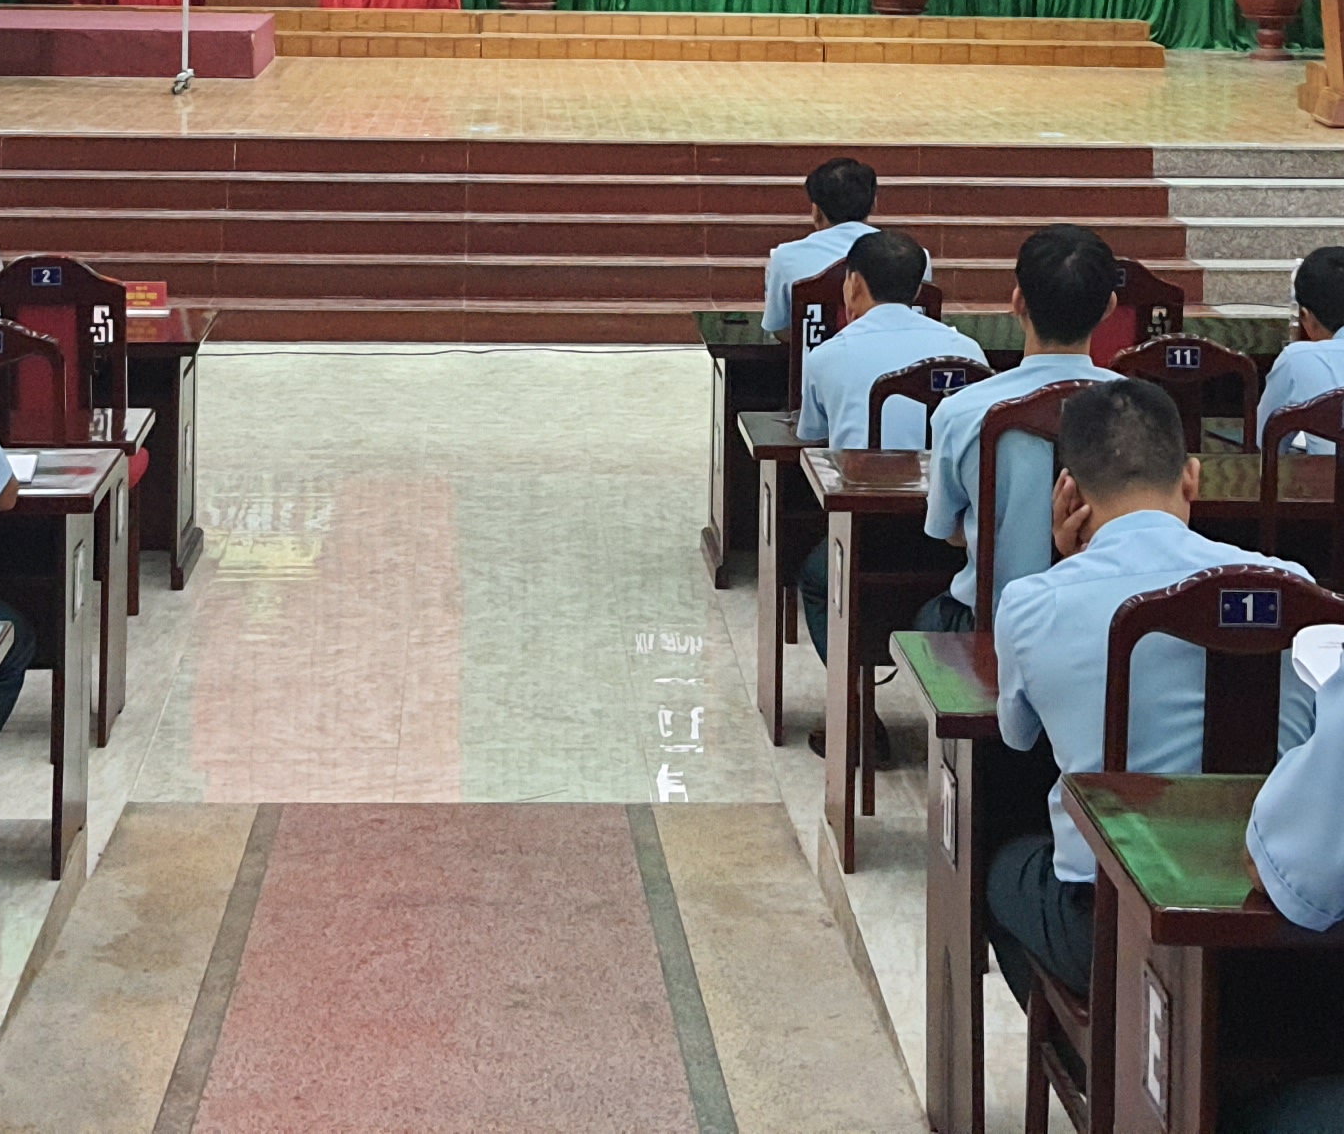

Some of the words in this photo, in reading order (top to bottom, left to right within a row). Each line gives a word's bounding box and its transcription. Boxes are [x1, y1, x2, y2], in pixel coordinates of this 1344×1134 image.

[42, 269, 51, 283] 2
[1173, 348, 1192, 365] 11
[943, 371, 953, 388] 7
[1240, 593, 1255, 622] 1
